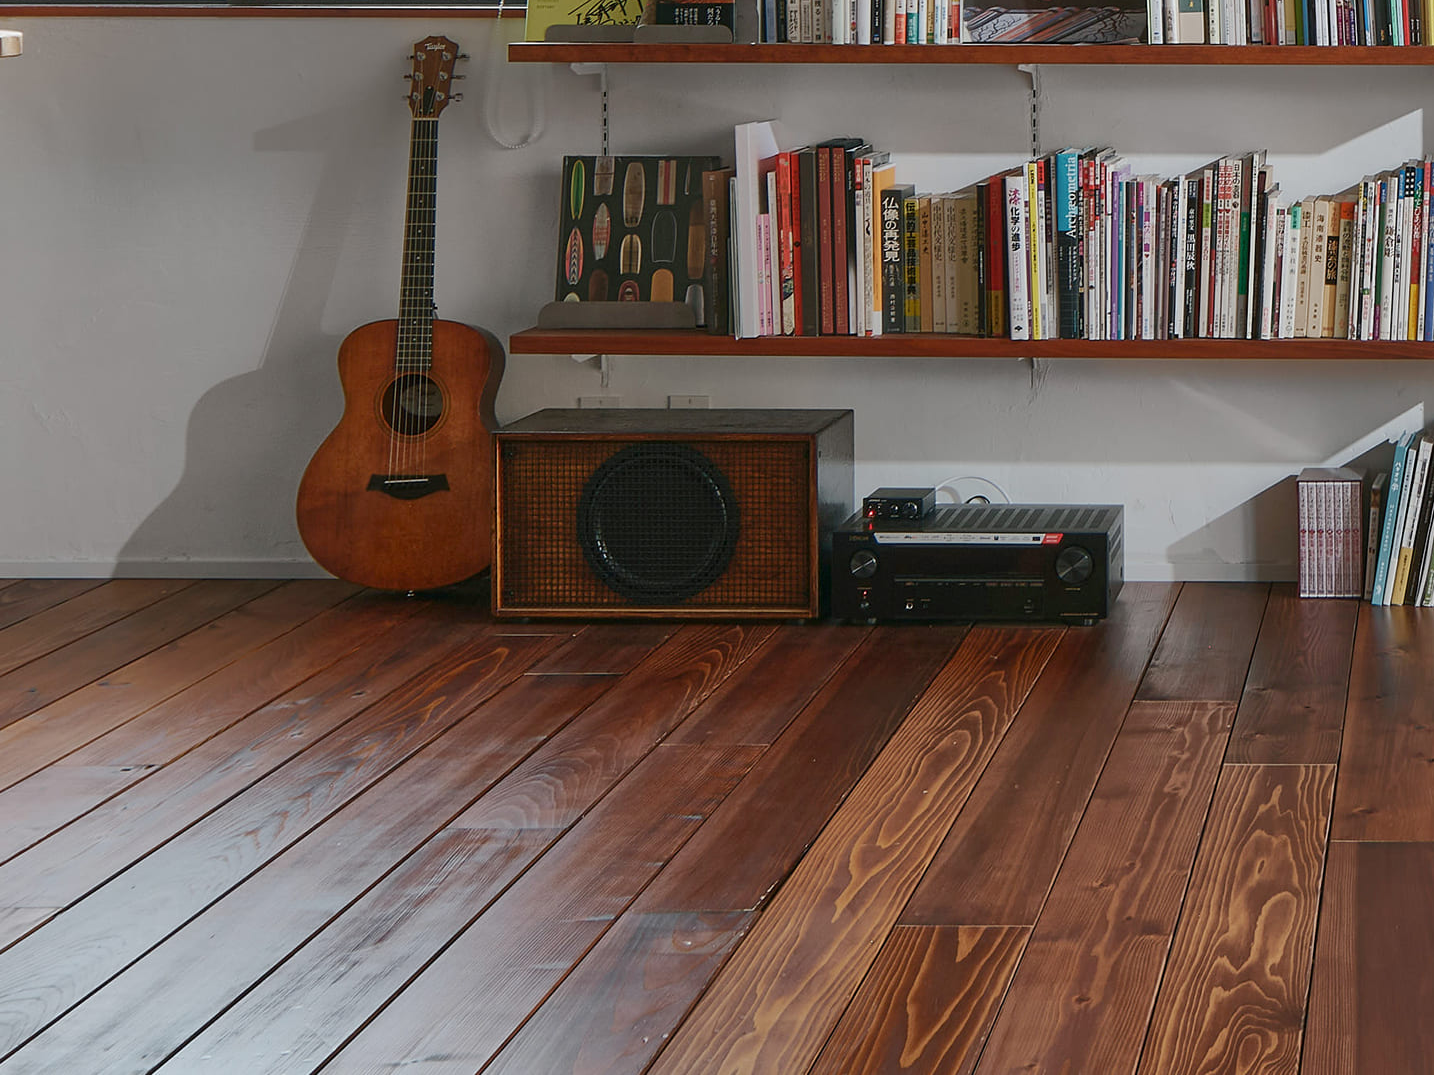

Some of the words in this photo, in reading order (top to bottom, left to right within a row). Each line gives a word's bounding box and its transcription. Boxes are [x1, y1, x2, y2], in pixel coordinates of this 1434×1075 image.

[425, 42, 446, 52] Taylor
[882, 196, 900, 263] 仏像の再発見
